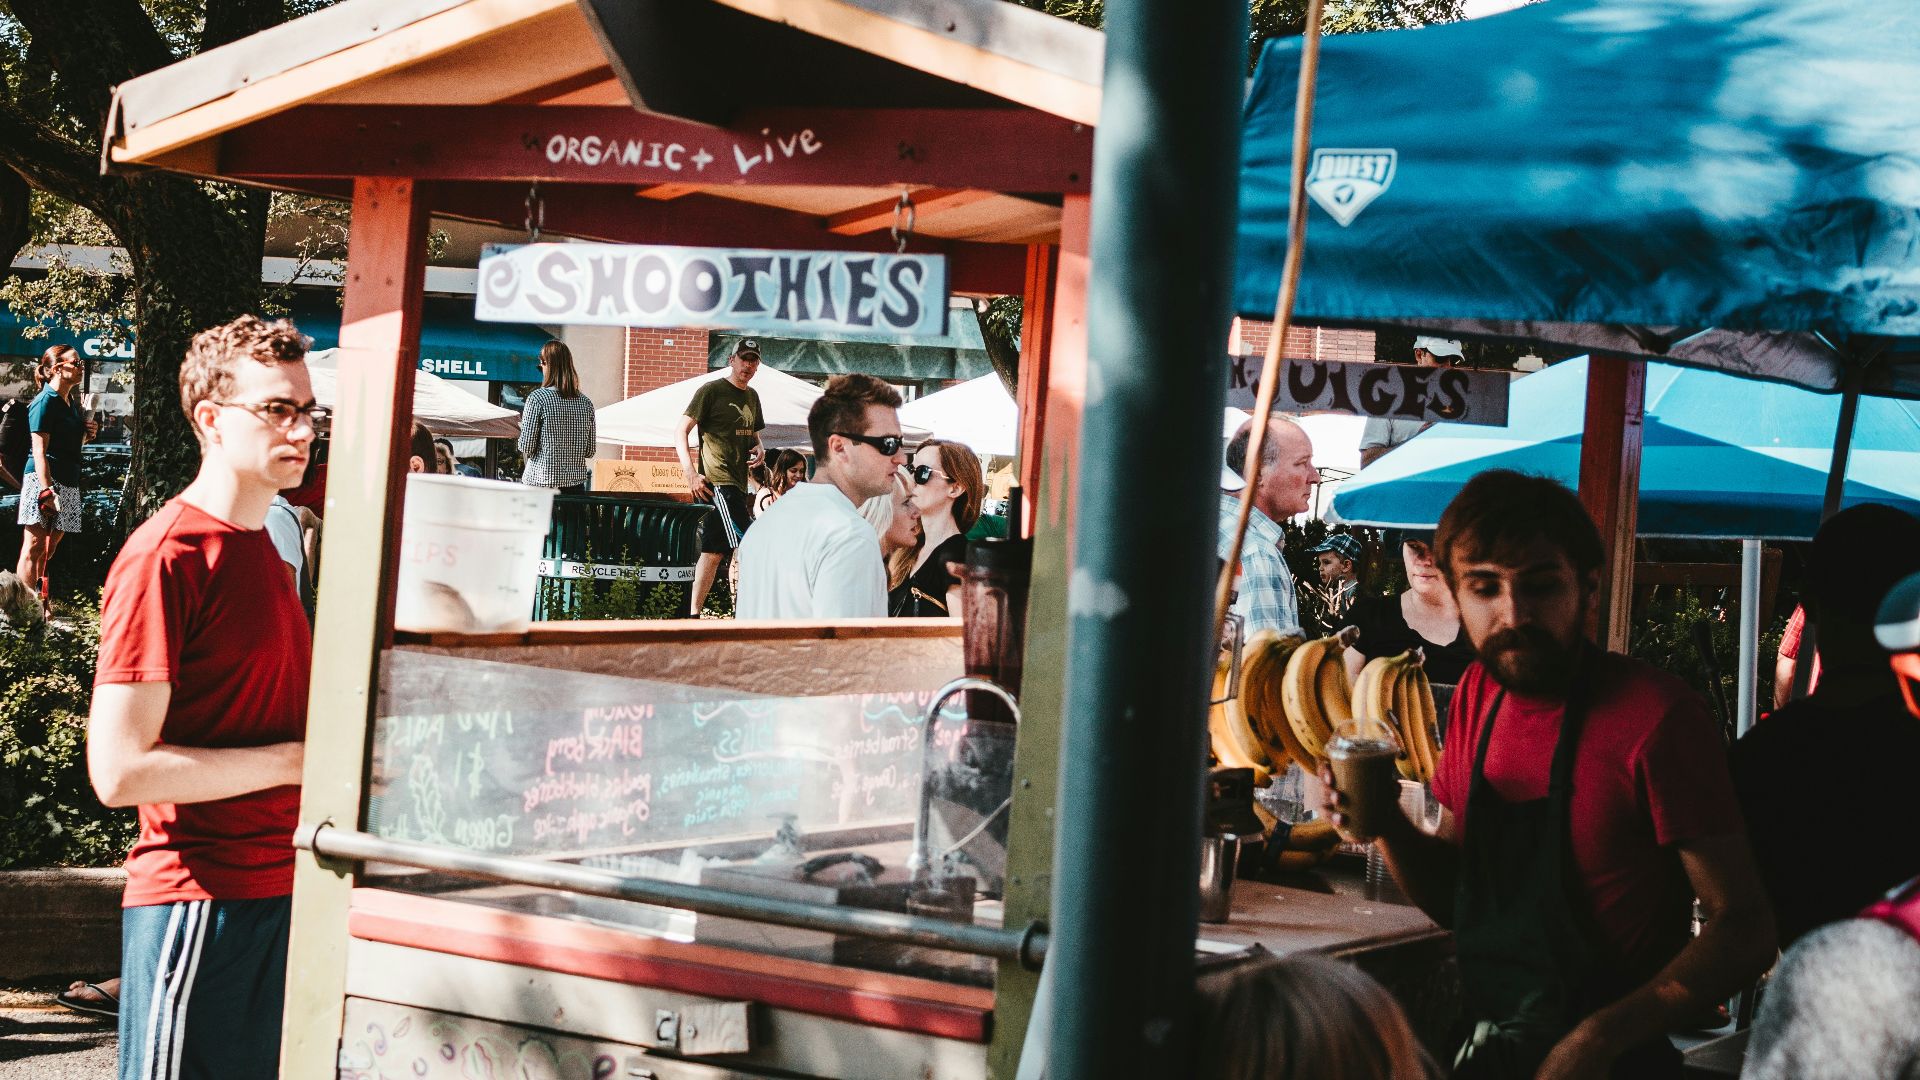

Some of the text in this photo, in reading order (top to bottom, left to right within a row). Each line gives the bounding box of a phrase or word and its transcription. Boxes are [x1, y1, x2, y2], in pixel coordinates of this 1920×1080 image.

[546, 133, 684, 171] ORGANIC
[1316, 154, 1390, 182] QUEST
[421, 358, 488, 376] SHELL
